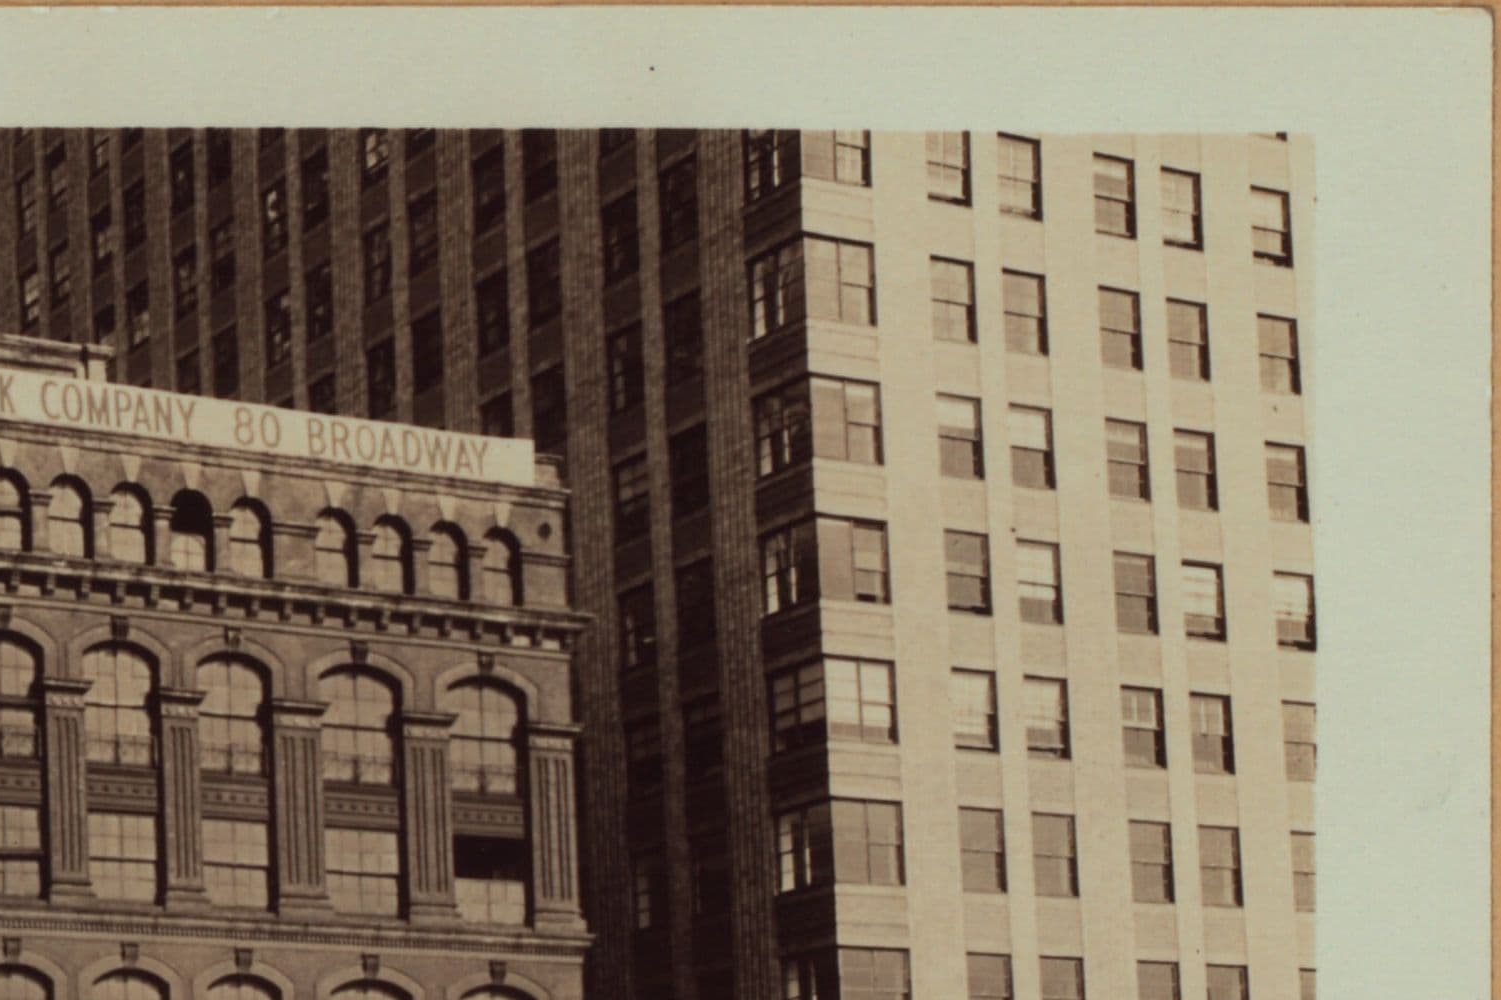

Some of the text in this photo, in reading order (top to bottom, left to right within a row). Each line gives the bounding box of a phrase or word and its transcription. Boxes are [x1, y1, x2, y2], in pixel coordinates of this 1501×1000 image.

[40, 379, 197, 439] COMPANY
[233, 406, 282, 450] 80
[308, 421, 491, 476] BROADWAY
